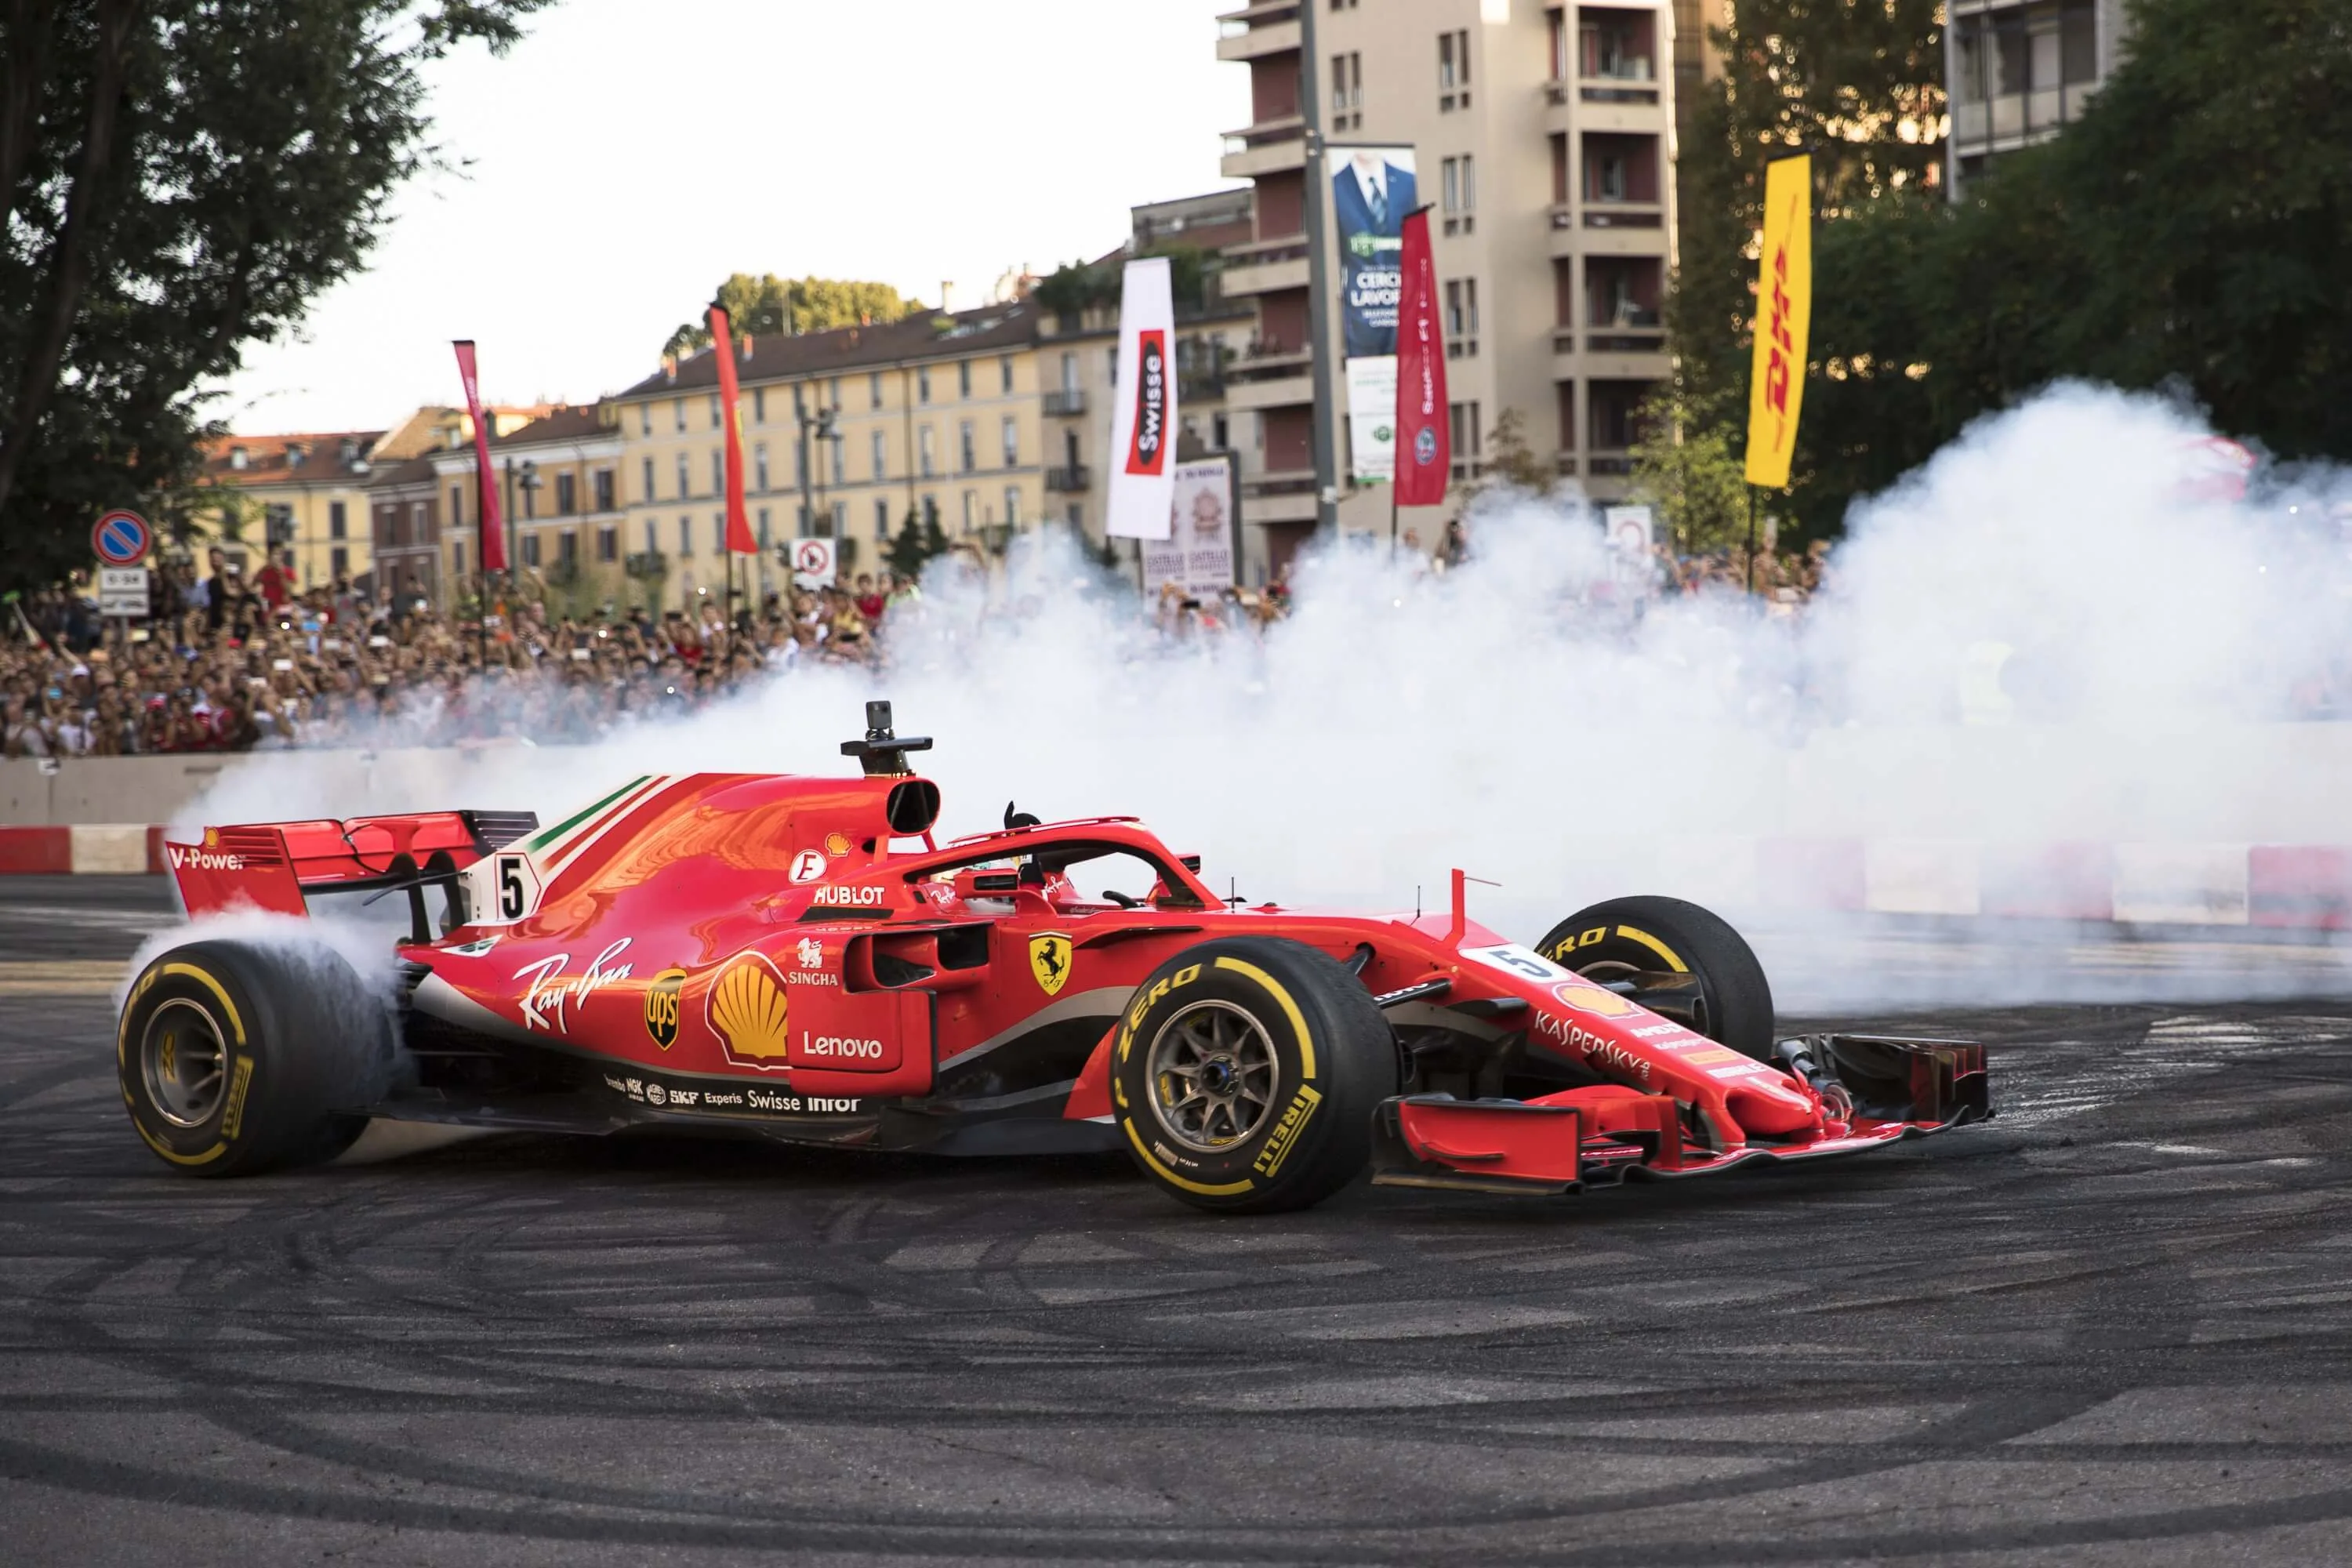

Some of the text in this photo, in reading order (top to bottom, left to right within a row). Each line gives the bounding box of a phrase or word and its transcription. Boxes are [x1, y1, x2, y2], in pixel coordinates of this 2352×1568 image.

[1766, 245, 1792, 416] DHL
[1138, 355, 1162, 452] Swisse
[500, 858, 524, 919] 5
[814, 886, 884, 905] HUBLOT
[789, 971, 838, 985] SINGHA
[1487, 950, 1553, 978] 5
[647, 990, 677, 1037] ups
[1116, 963, 1202, 1064] ZERO
[804, 1031, 883, 1058] Lenovo
[1534, 1010, 1642, 1072] KASPERSKY
[670, 1090, 699, 1105] SKF
[704, 1092, 743, 1106] Experis
[747, 1089, 801, 1111] Swisse
[1252, 1083, 1323, 1177] PIRELLI
